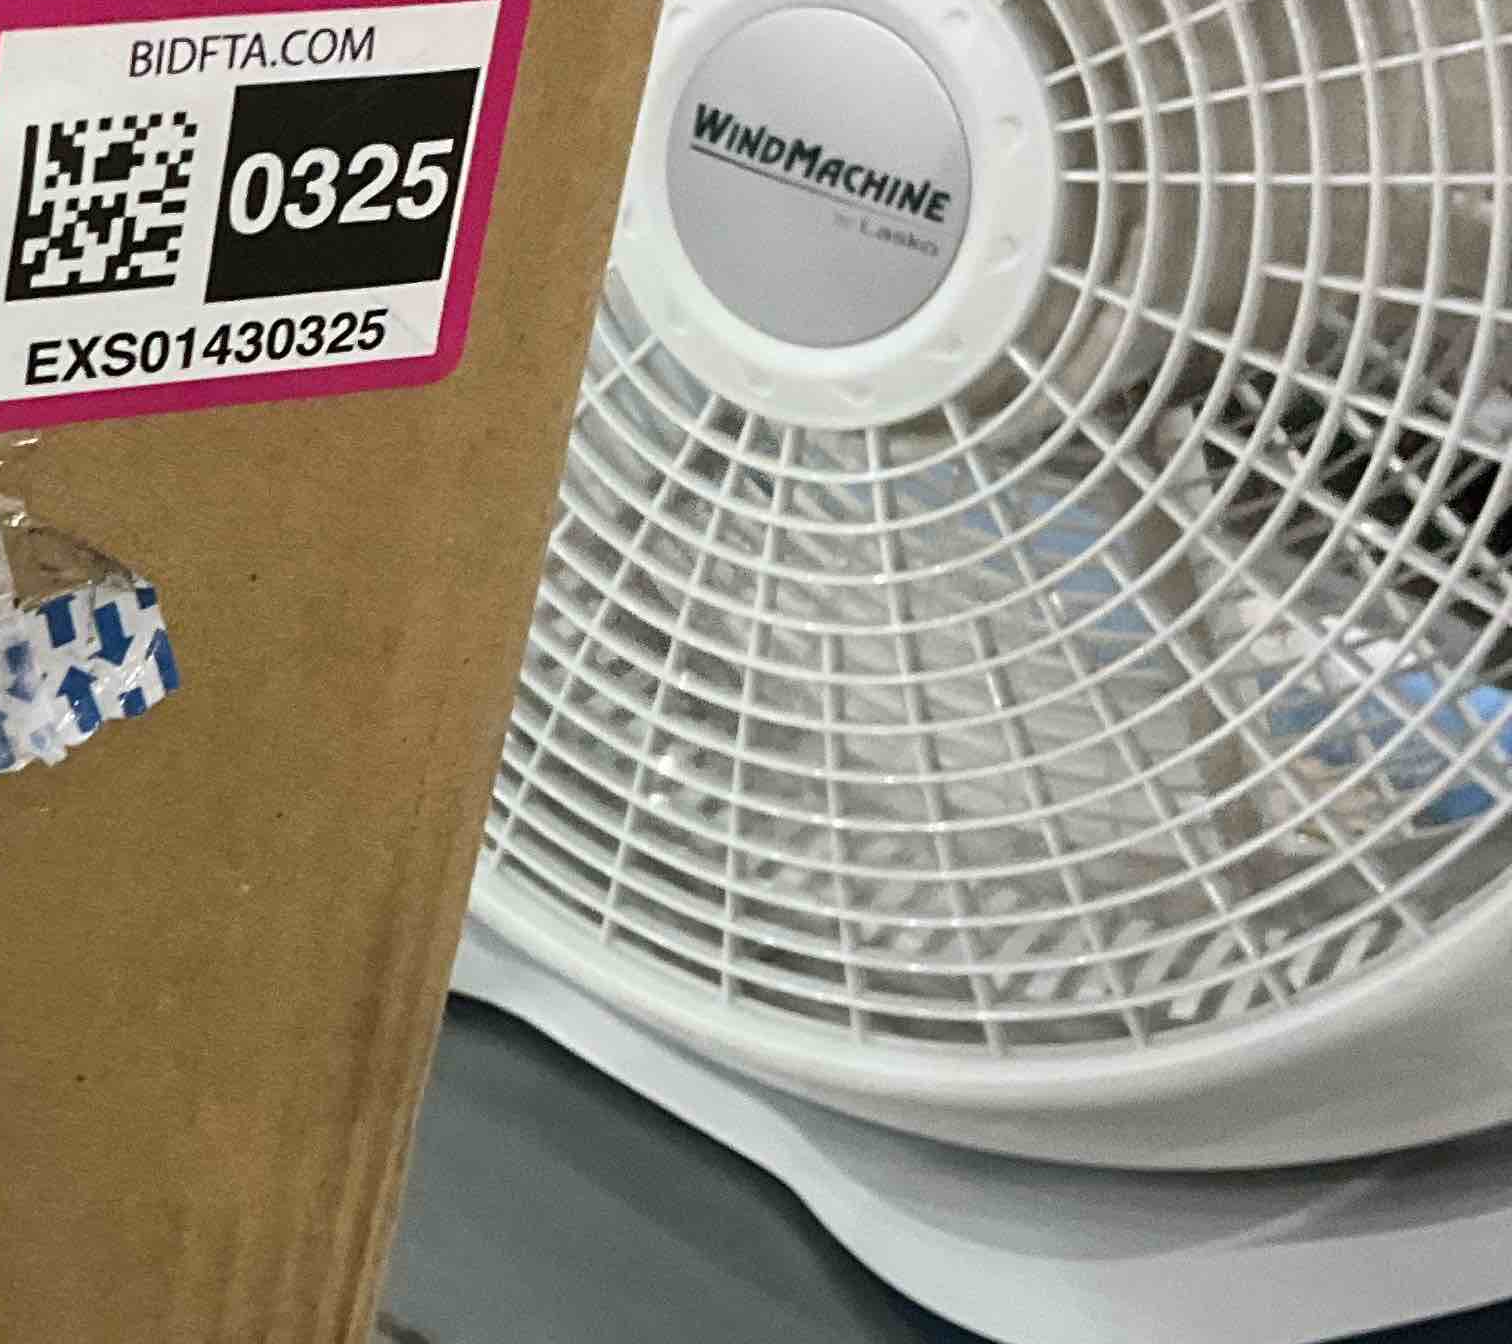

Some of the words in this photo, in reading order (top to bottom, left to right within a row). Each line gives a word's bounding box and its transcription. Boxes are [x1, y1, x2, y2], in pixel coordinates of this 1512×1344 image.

[129, 27, 376, 77] BIDFTA.COM
[228, 140, 454, 234] 0325
[26, 309, 388, 385] EXS01430325
